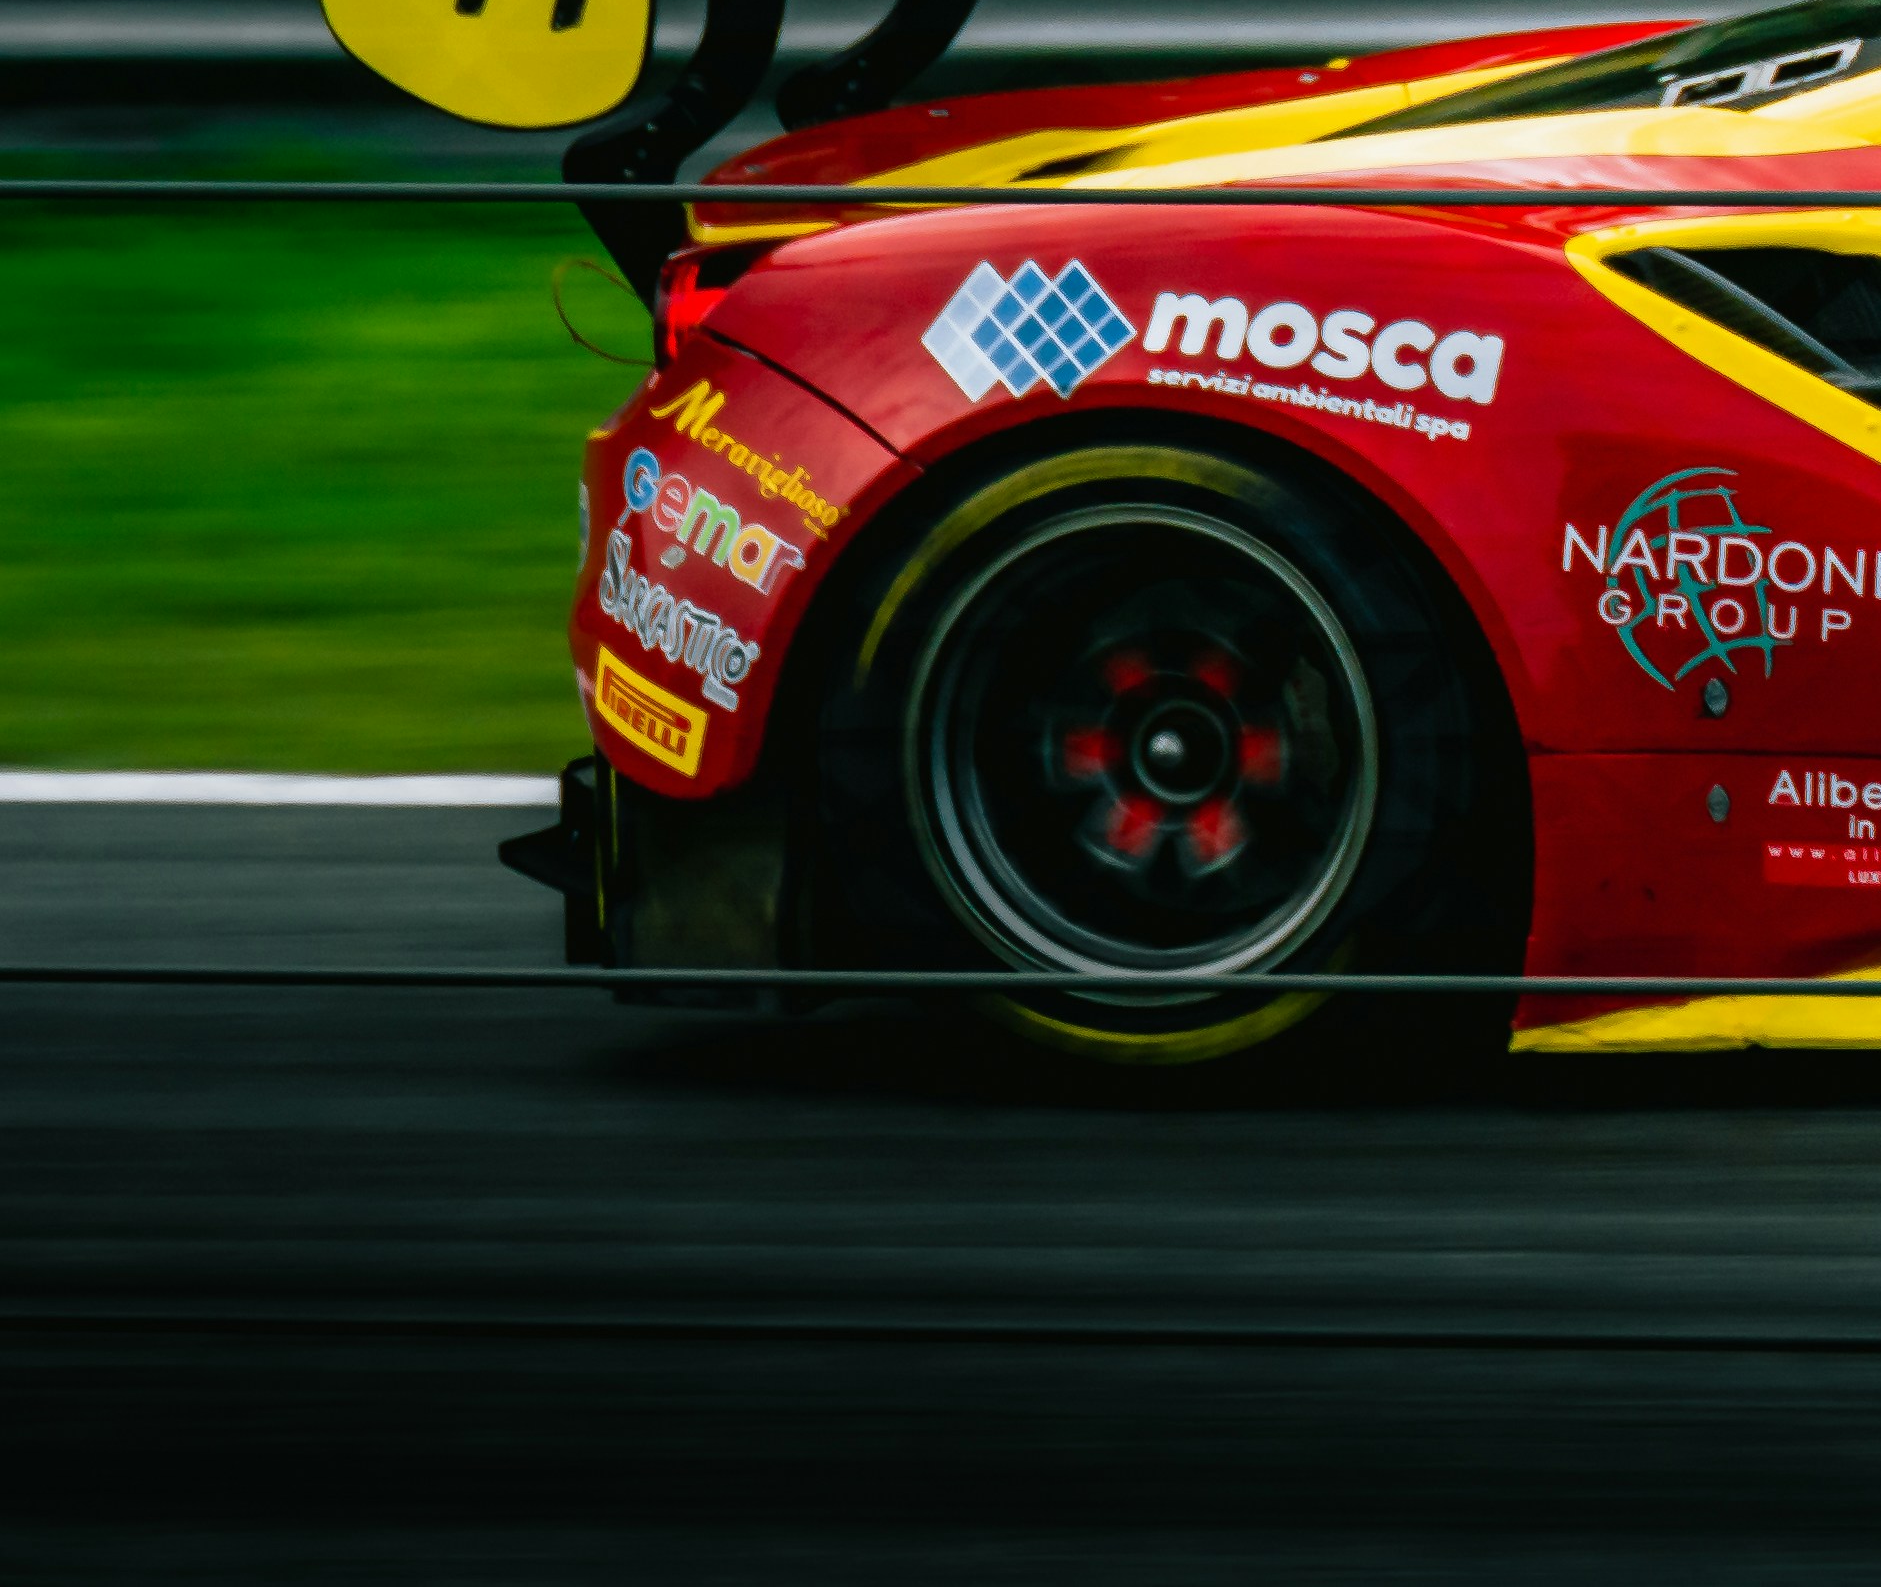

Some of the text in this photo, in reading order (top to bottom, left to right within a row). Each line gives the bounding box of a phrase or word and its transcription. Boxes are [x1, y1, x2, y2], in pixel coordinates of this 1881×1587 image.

[1142, 291, 1505, 405] mosca
[1148, 368, 1472, 442] servizi ambientali spa
[624, 446, 807, 596] Gemar
[1598, 588, 1852, 642] GROUP
[602, 665, 692, 758] PIRELLI
[1849, 814, 1875, 840] in
